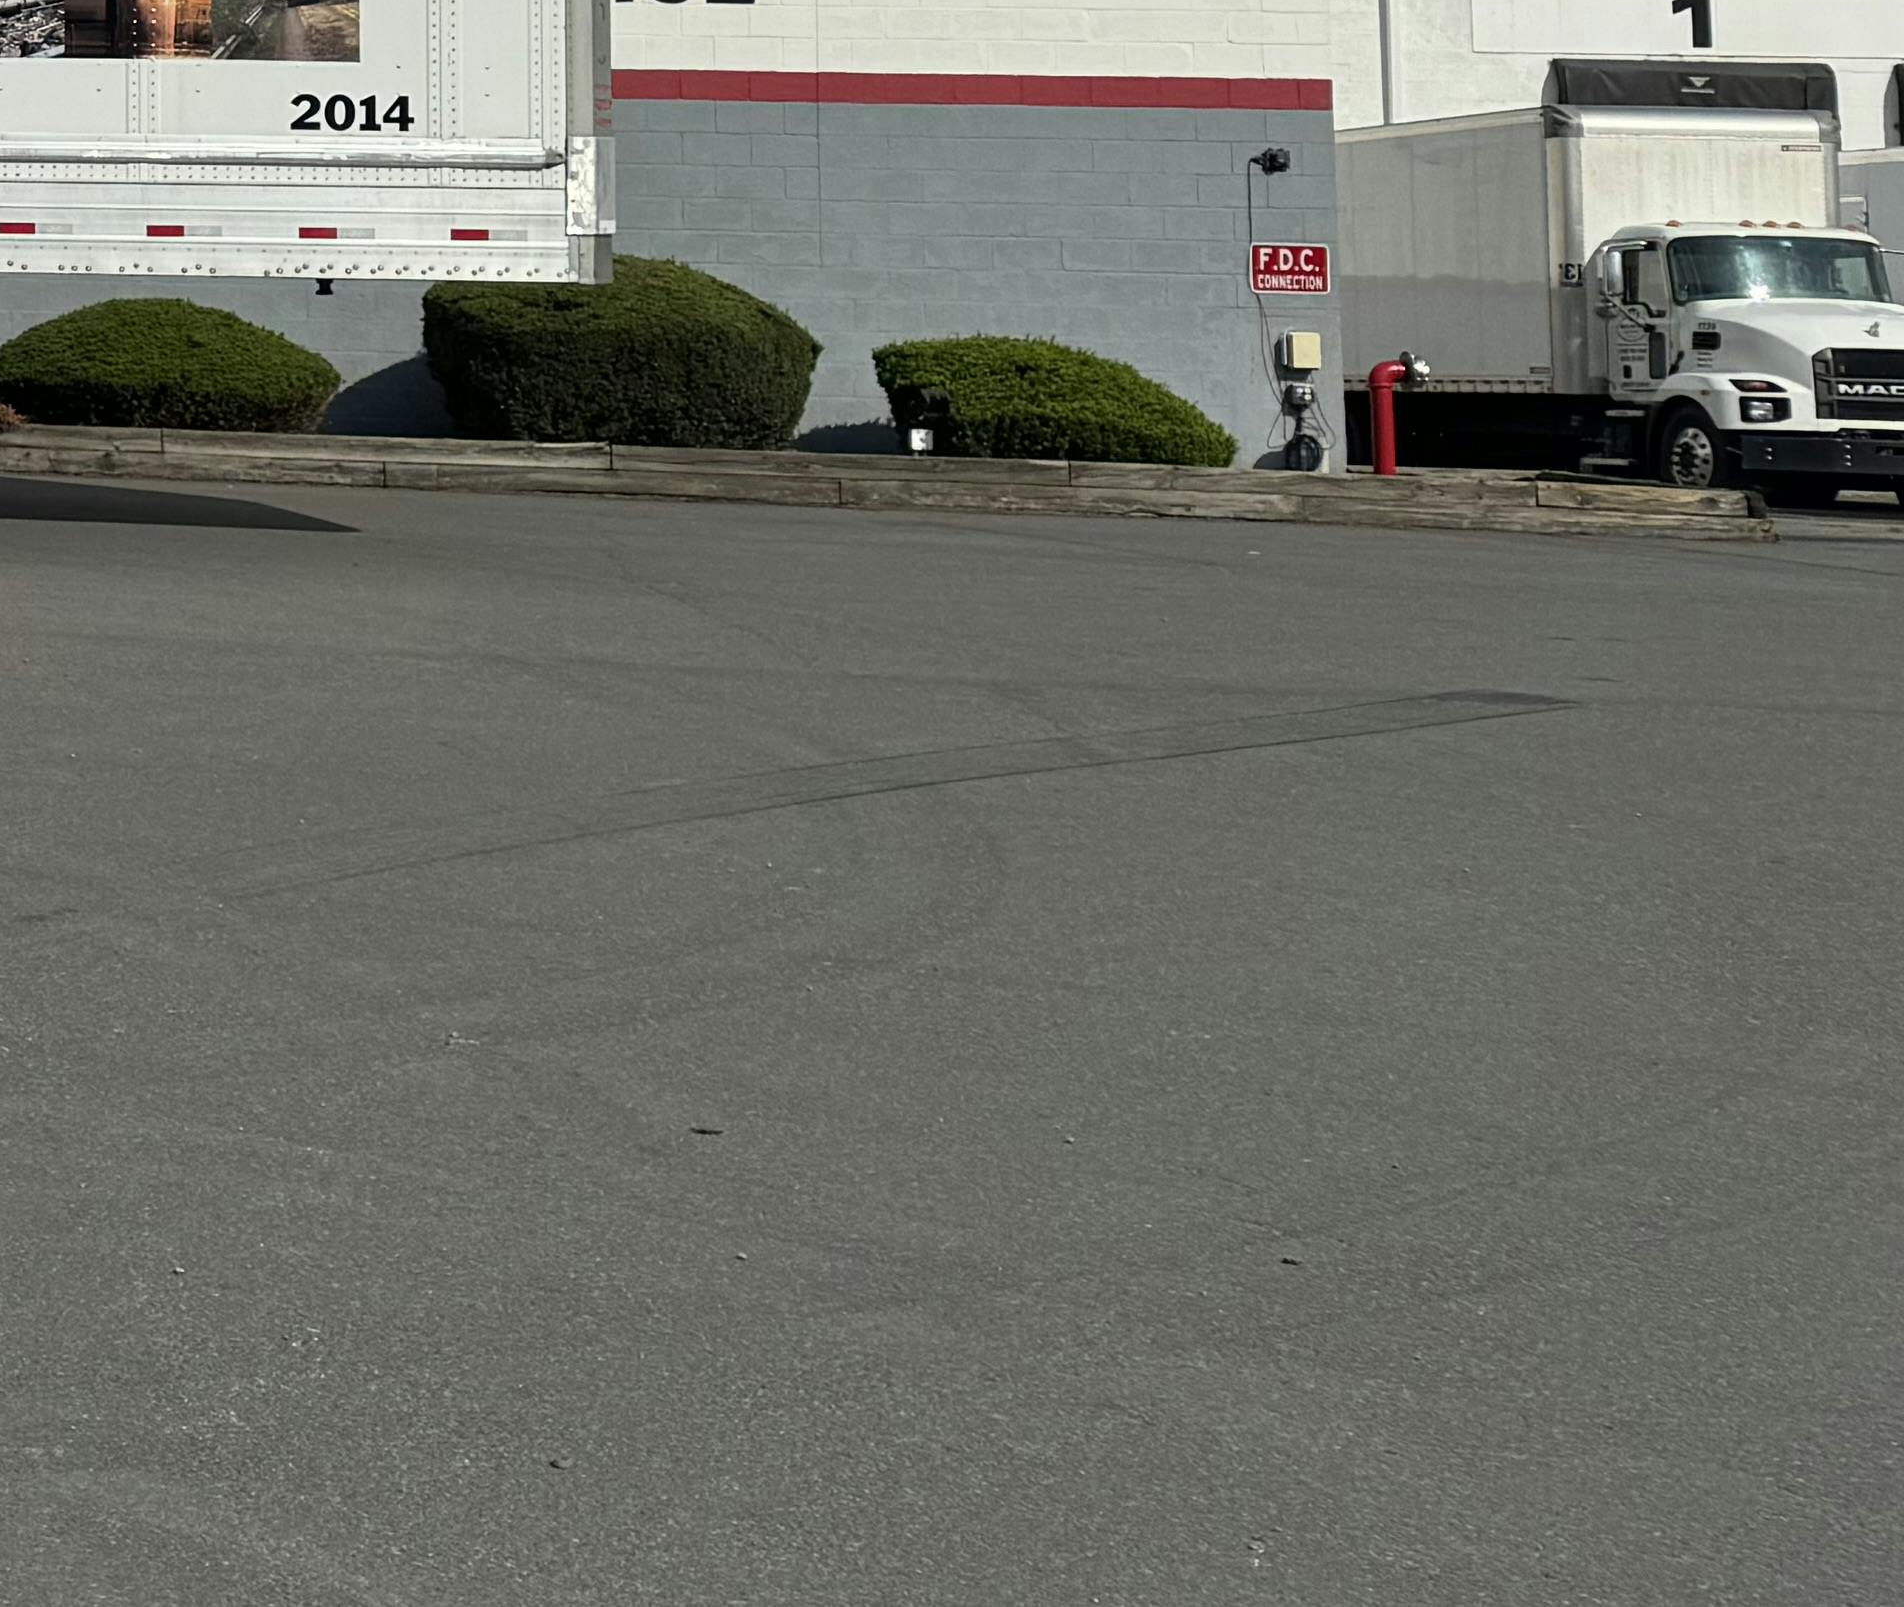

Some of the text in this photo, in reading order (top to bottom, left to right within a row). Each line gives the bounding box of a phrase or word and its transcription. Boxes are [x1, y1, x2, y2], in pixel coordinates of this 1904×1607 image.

[289, 93, 415, 132] 2014
[1259, 247, 1320, 272] F.D.C.
[1257, 274, 1323, 290] CONNECTION
